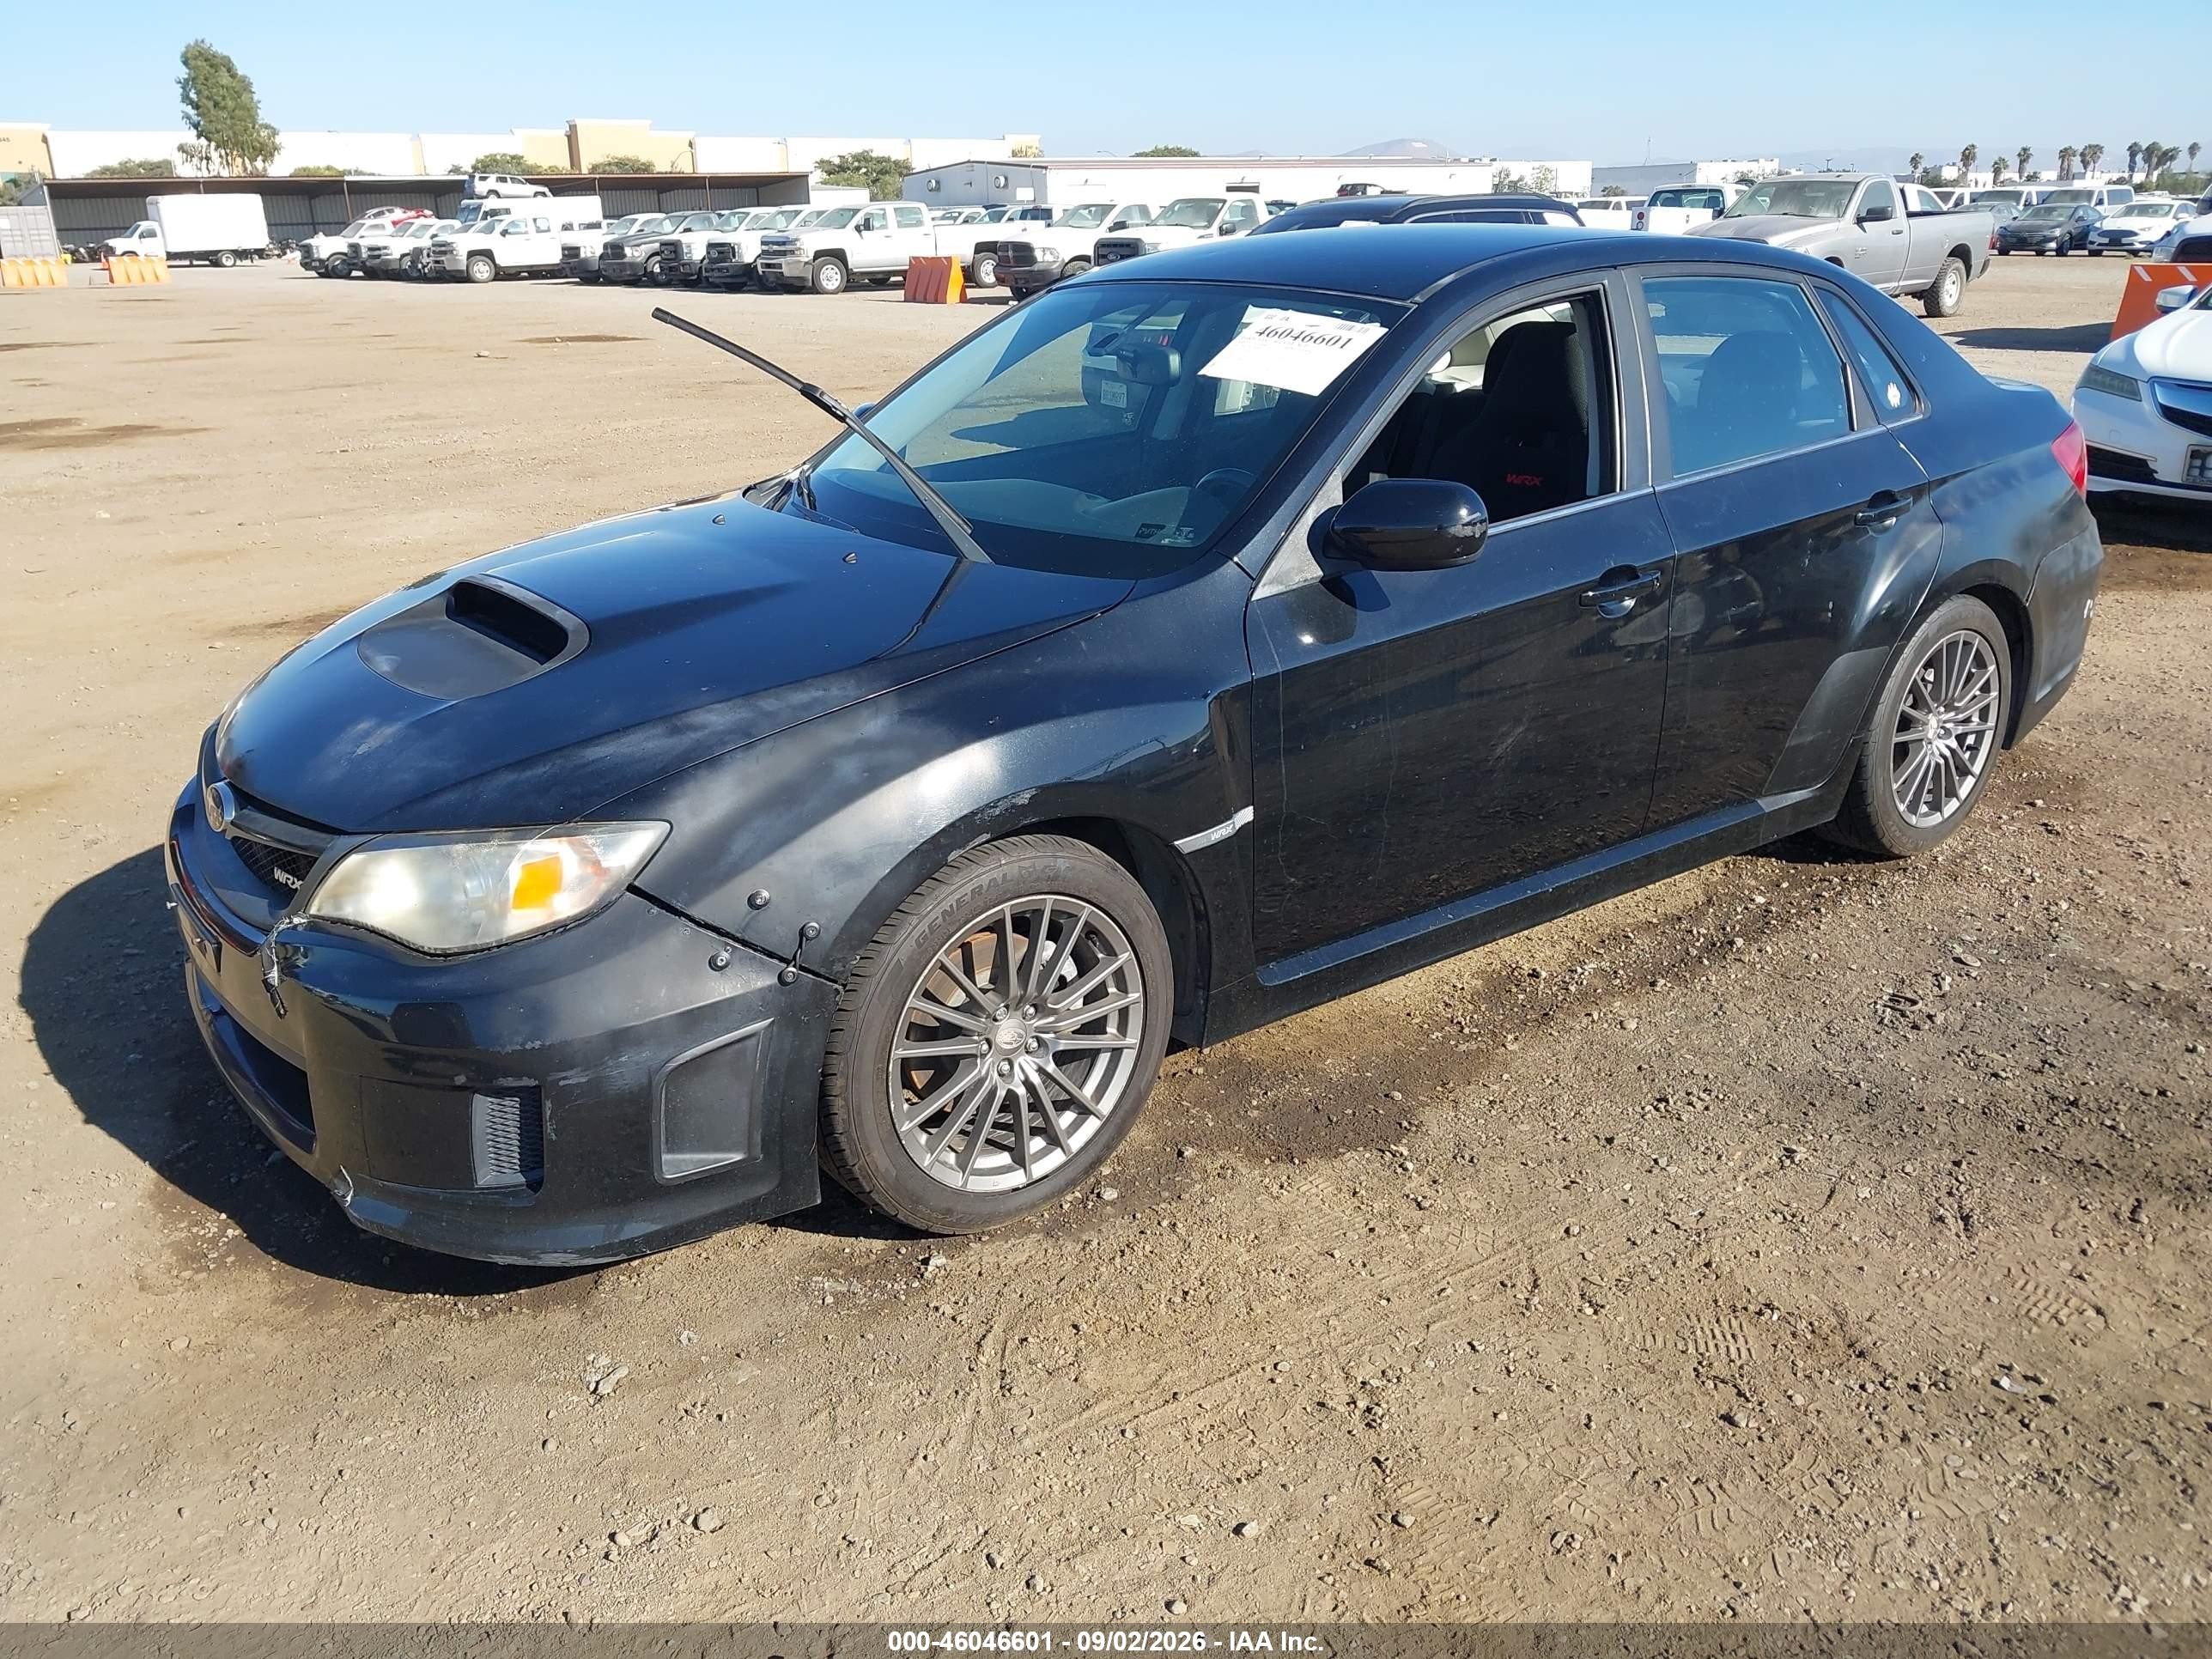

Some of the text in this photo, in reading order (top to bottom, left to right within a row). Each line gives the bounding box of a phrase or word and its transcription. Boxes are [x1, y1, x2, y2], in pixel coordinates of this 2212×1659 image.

[1255, 325, 1353, 349] 46046601
[1505, 473, 1544, 487] WRX
[1211, 823, 1234, 840] WRX
[273, 866, 303, 890] WRX
[914, 872, 1014, 950] GENERAL
